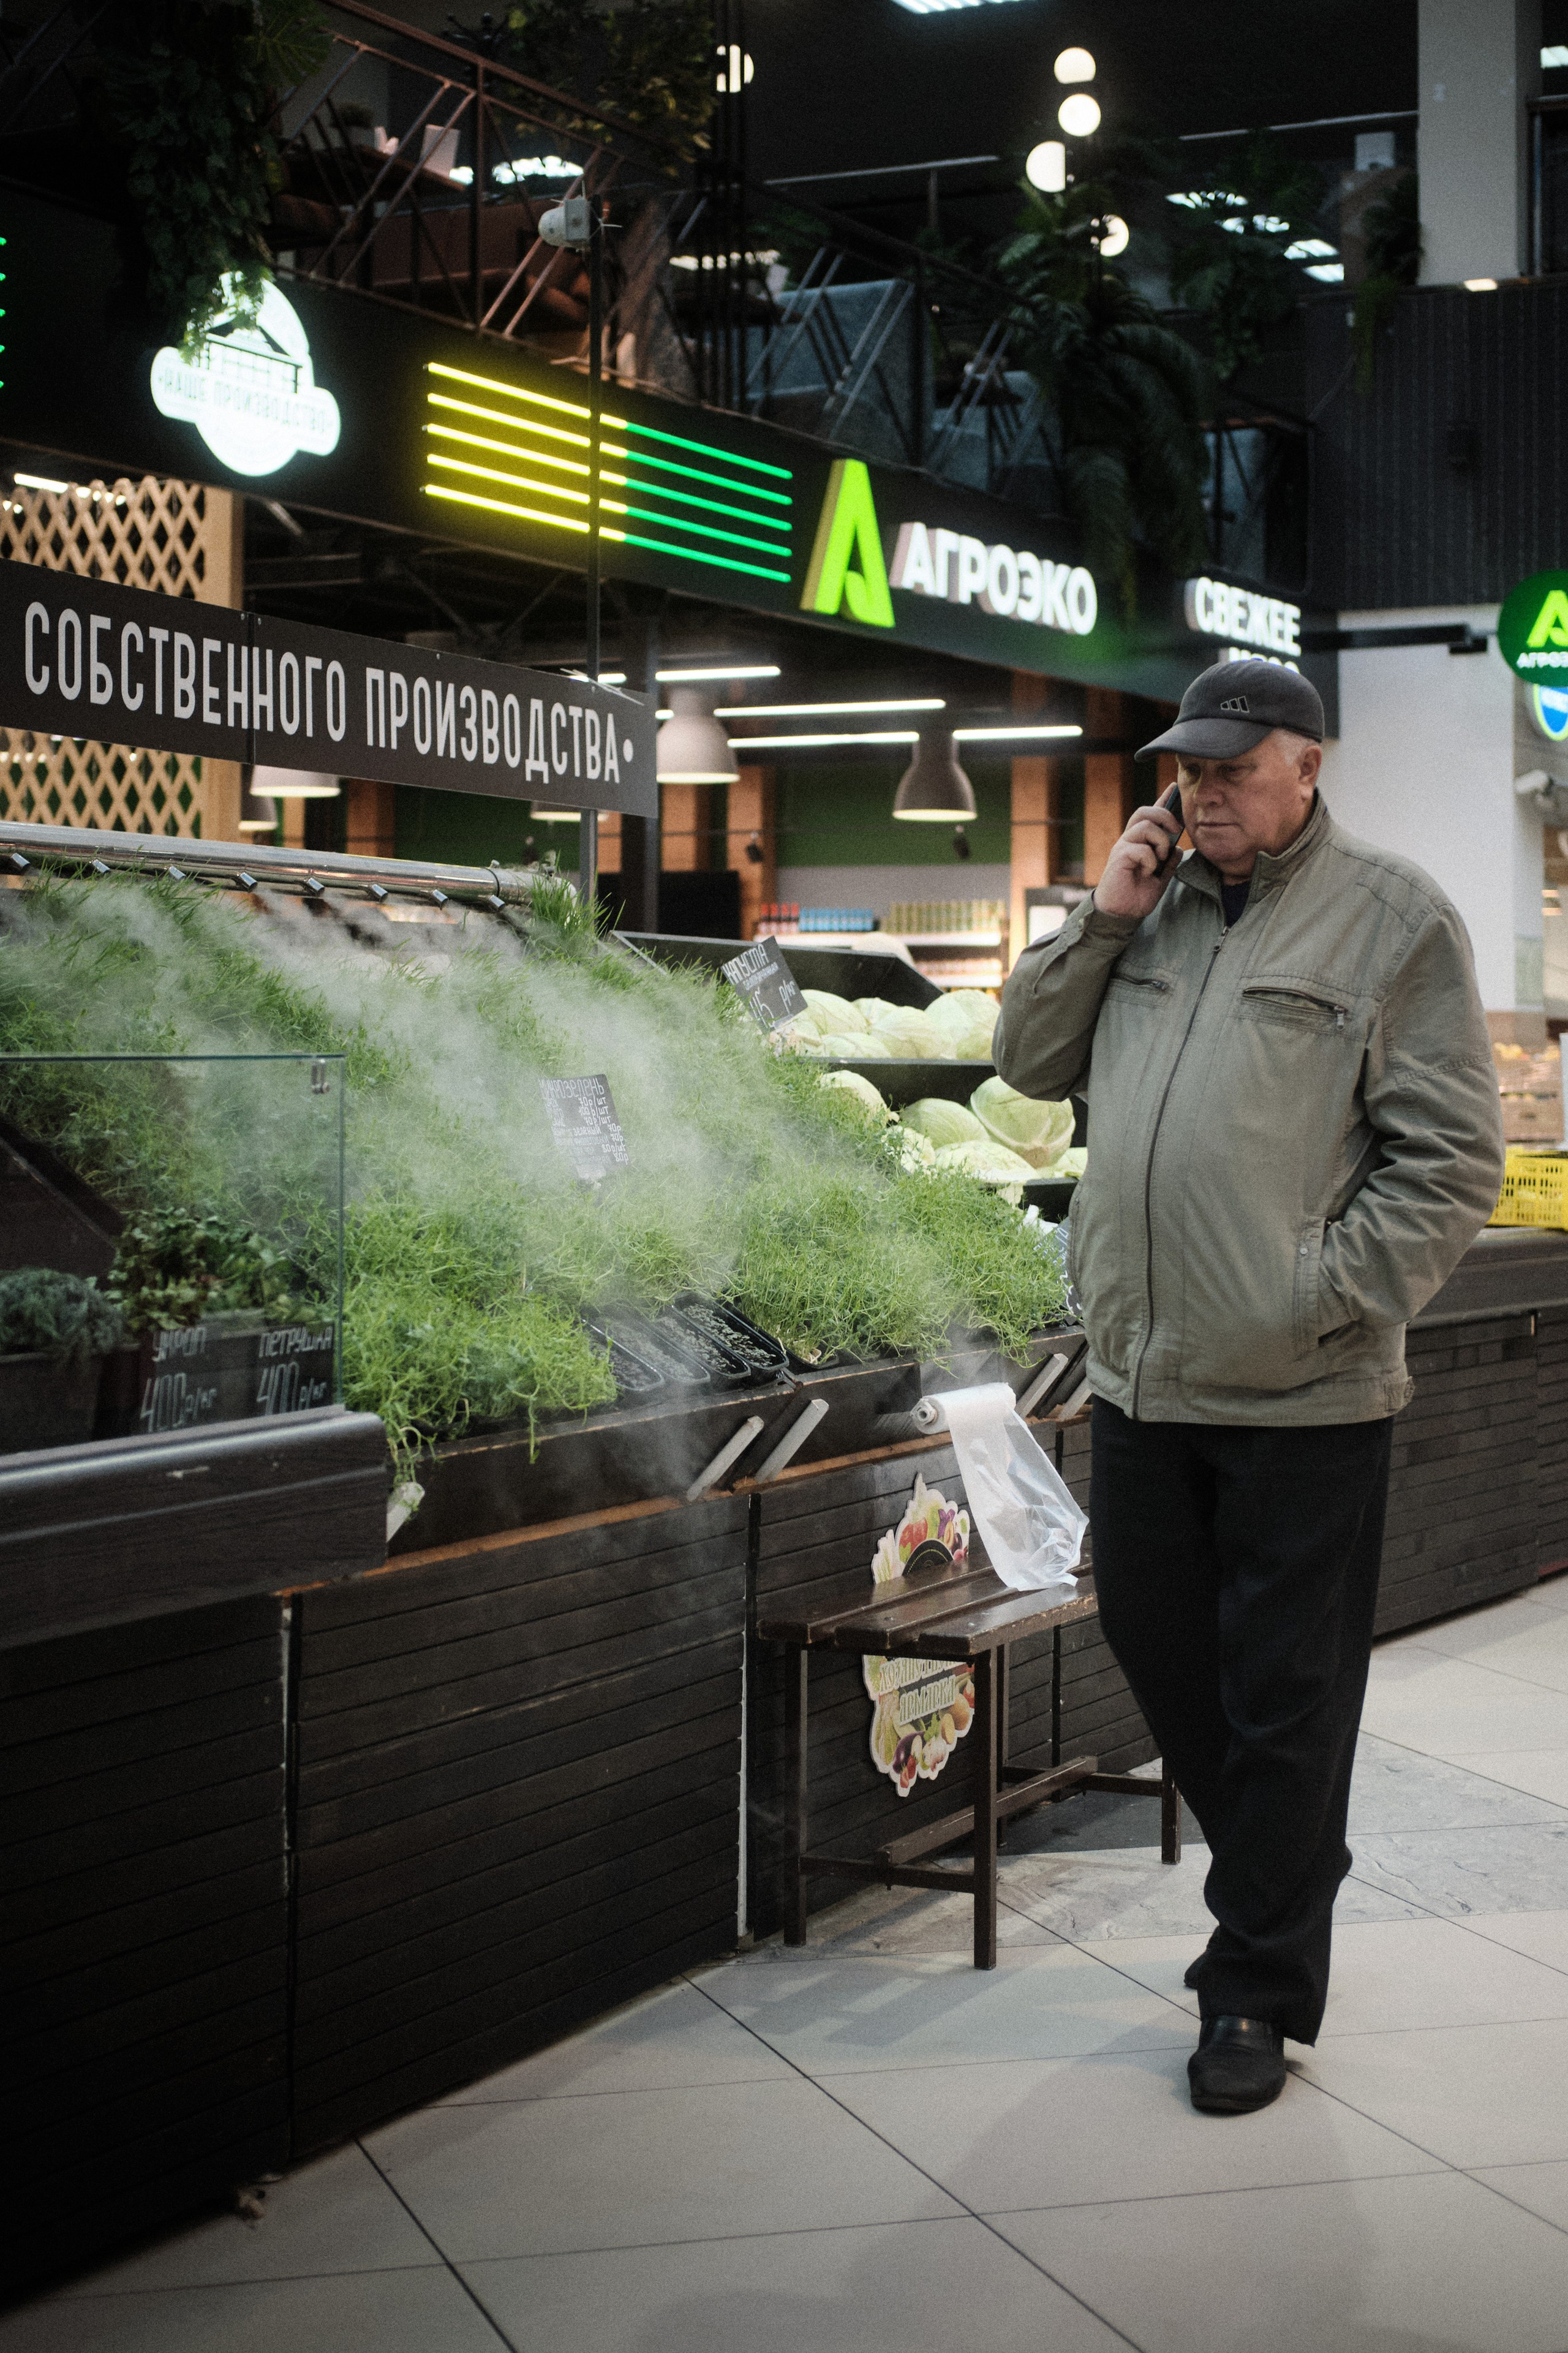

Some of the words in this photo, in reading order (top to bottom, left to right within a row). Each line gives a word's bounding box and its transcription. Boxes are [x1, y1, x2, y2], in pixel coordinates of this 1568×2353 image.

[164, 366, 206, 402] НАШЕ
[214, 380, 326, 434] ПРОИЗВОДСТВО
[893, 522, 1098, 636] АГРОЭКО
[1187, 576, 1302, 657] СВЕЖЕЕ
[24, 600, 347, 742] СОБСТВЕННОГО
[366, 667, 620, 784] ПРОИЗВОДСТВА
[899, 1674, 957, 1726] ЯРМАРКА
